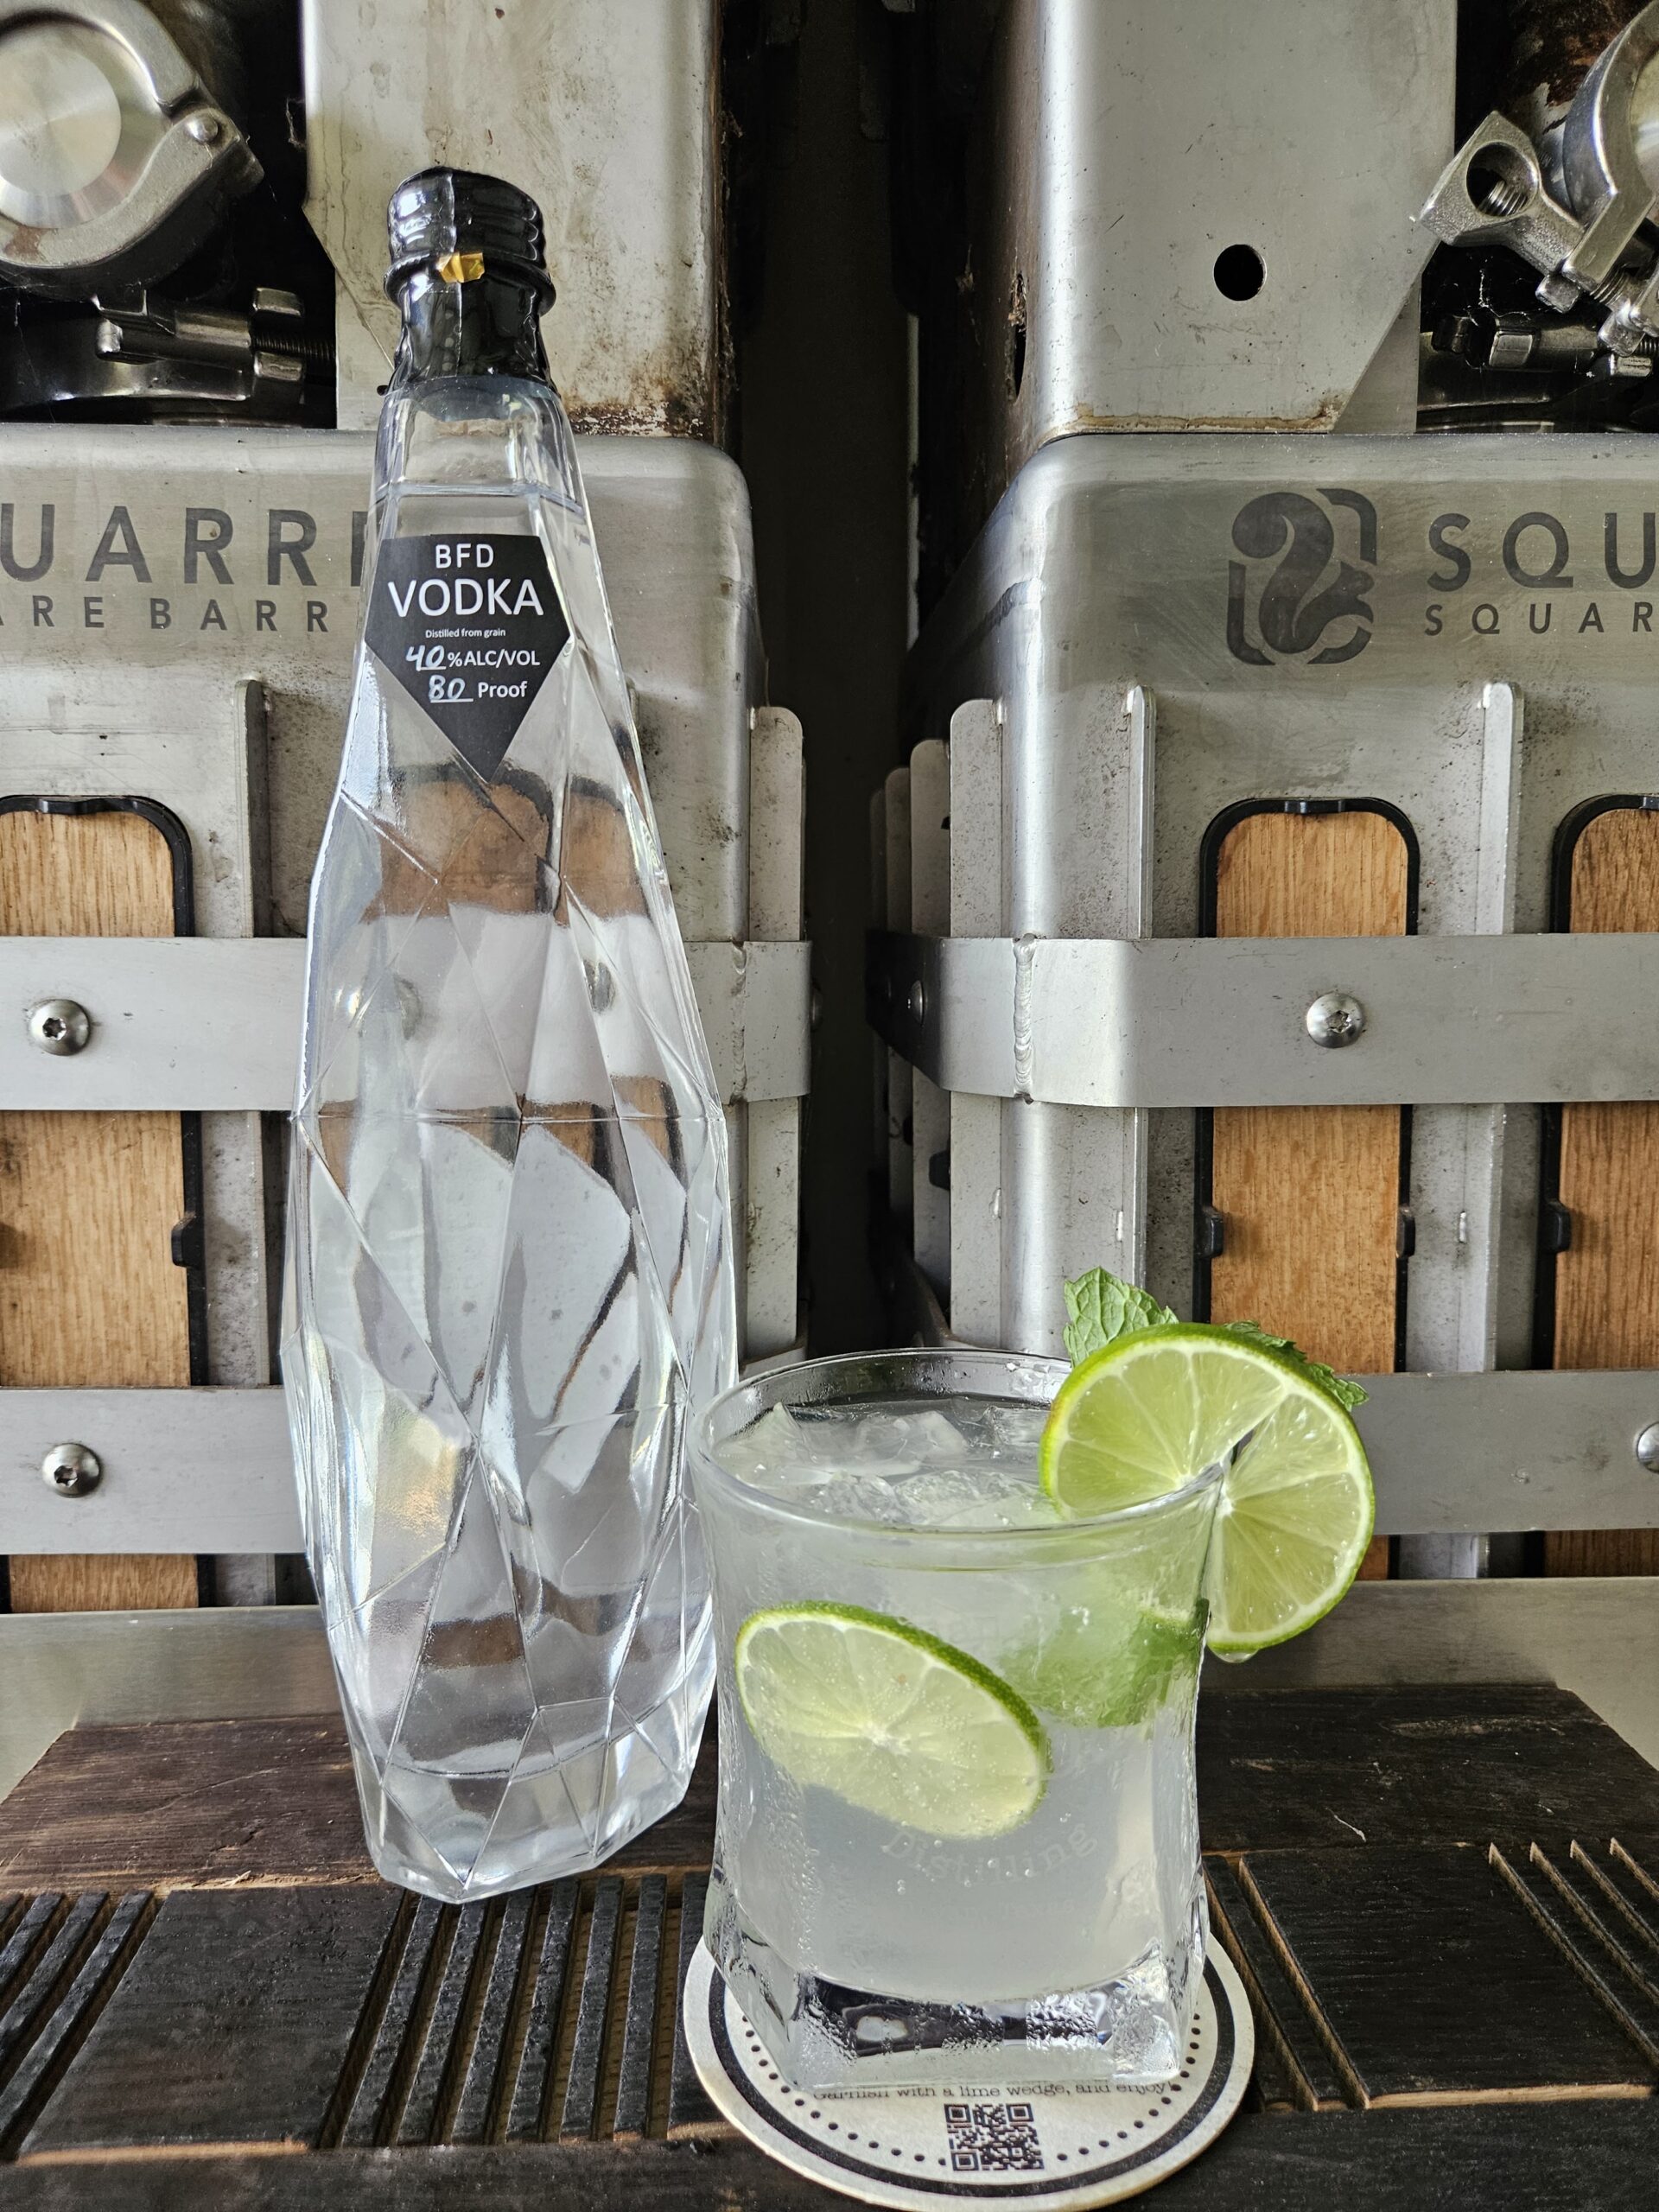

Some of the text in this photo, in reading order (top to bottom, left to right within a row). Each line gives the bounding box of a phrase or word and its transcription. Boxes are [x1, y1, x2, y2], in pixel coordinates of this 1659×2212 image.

[435, 543, 494, 569] BFD
[1427, 512, 1656, 592] SQU
[0, 594, 328, 632] RE BARR
[388, 578, 544, 617] VODKA
[425, 627, 506, 639] Distilled from grain
[1424, 601, 1653, 637] SQUAR
[429, 674, 528, 702] 80 Proof
[959, 2085, 1001, 2098] lime
[1007, 2083, 1071, 2096] wedge,
